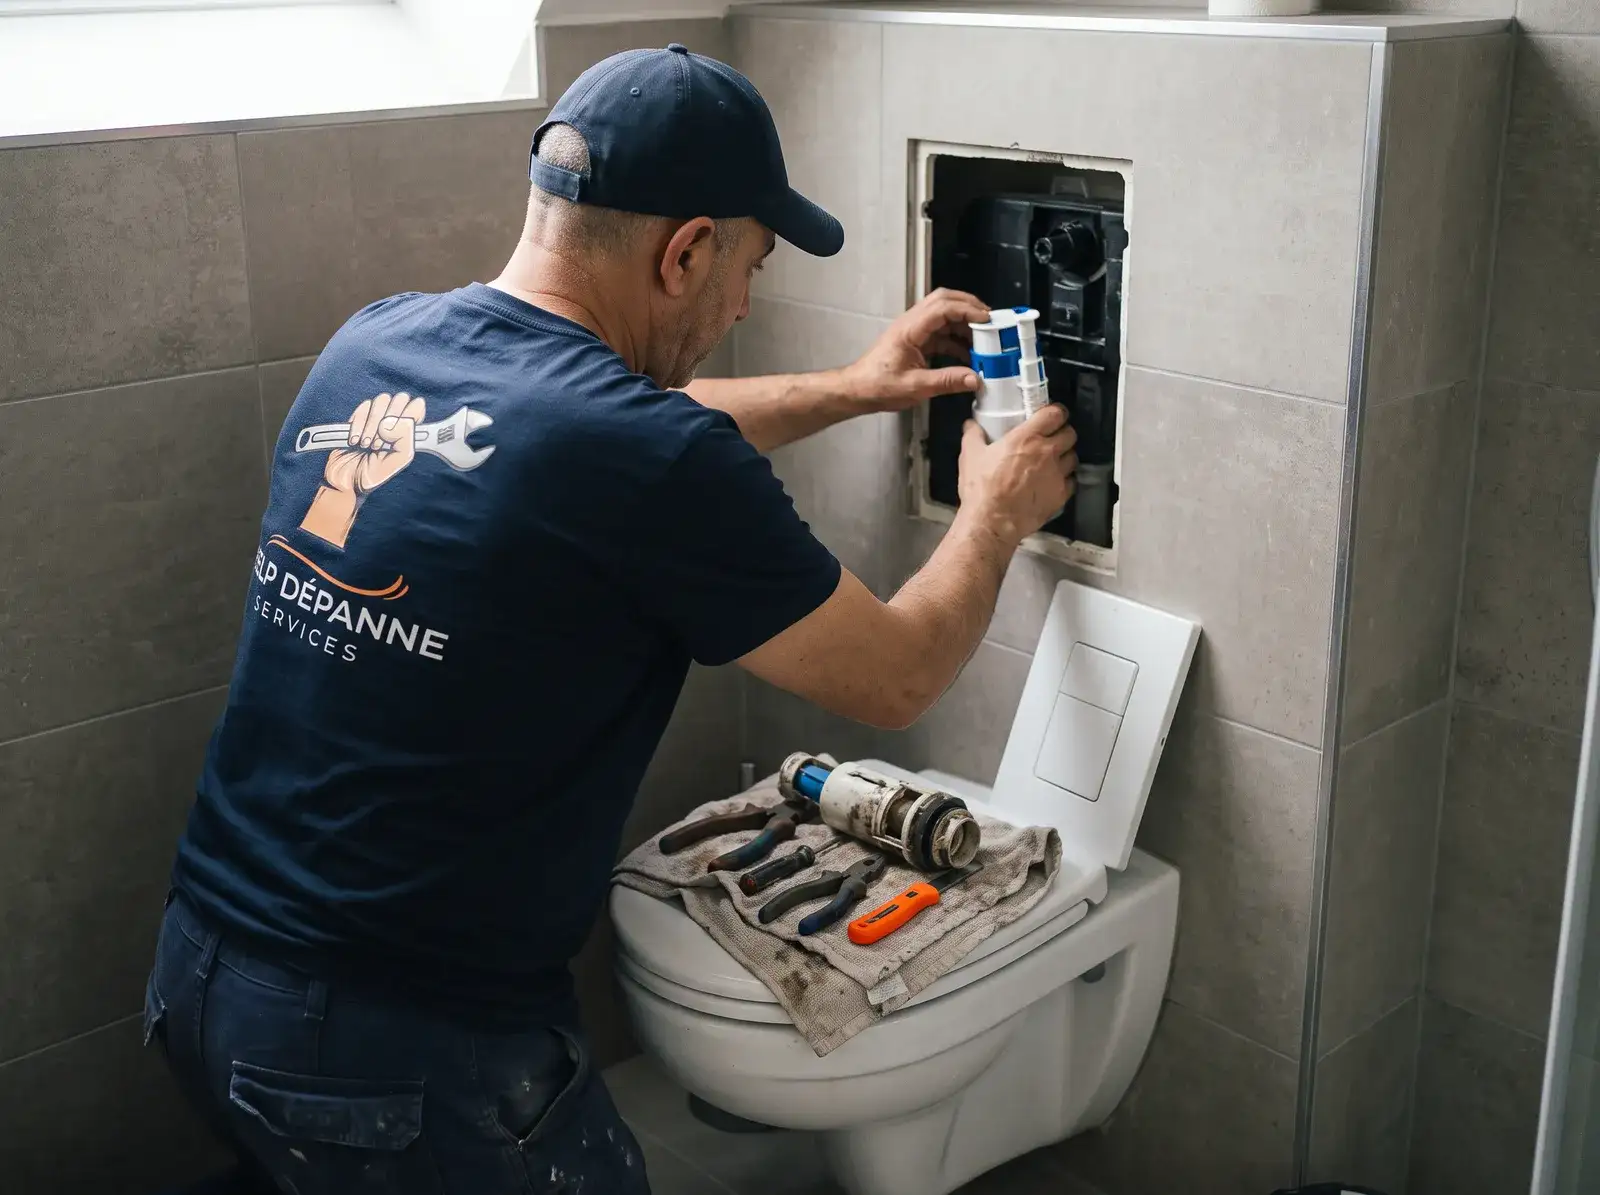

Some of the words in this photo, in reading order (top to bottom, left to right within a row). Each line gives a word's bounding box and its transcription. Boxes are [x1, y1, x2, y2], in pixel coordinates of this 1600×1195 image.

[254, 546, 278, 585] ELP
[279, 572, 449, 661] DÉPANNE
[254, 595, 357, 662] SERVICES
